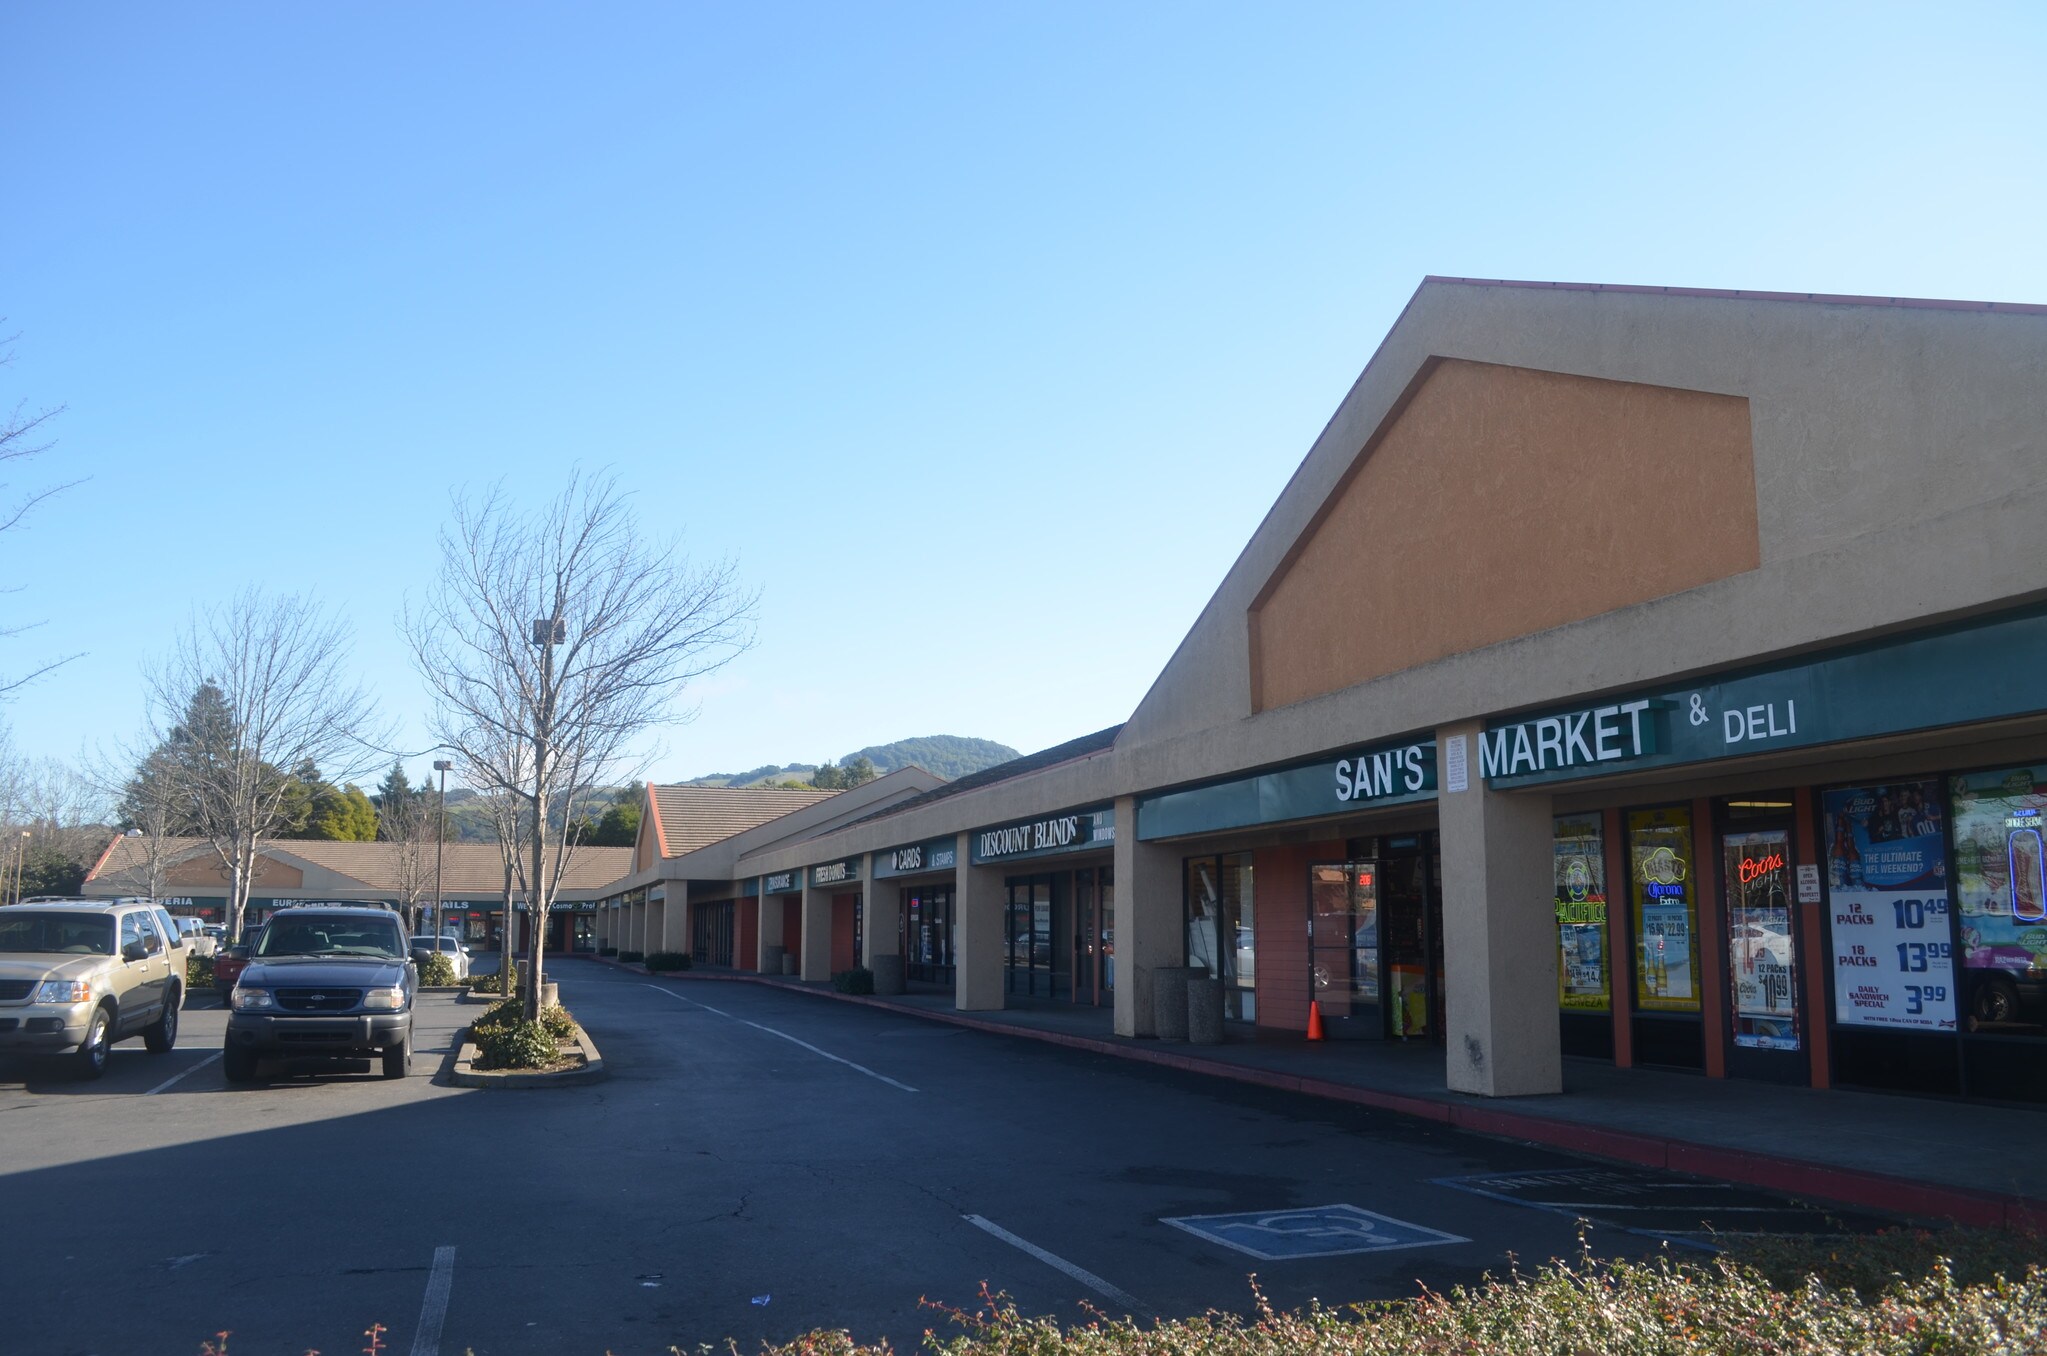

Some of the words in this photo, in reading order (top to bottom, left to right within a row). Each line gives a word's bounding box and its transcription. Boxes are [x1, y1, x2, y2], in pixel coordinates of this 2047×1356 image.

[1477, 699, 1650, 779] MARKET
[1689, 693, 1709, 726] &
[1724, 699, 1797, 744] DELI
[1335, 745, 1424, 801] SAN'S
[1849, 804, 1877, 813] LIGHT
[1093, 812, 1104, 826] AND
[980, 825, 1031, 857] DISCOUNT
[1033, 815, 1078, 849] BLINDS
[898, 846, 921, 870] CARDS
[936, 850, 953, 866] STAMPS
[1864, 853, 1879, 863] THE
[1881, 851, 1922, 863] ULTIMATE
[1738, 853, 1785, 882] Coors
[1865, 865, 1879, 874] NFL
[1880, 863, 1924, 874] WEEKEND?
[1745, 870, 1781, 894] LIGHT
[1648, 881, 1683, 898] Corona
[151, 897, 193, 905] DERIA
[441, 901, 469, 909] AILS
[552, 902, 573, 910] Cosmo
[1849, 903, 1862, 913] 12
[1836, 914, 1874, 925] PACKS
[1851, 945, 1865, 955] 18
[1838, 956, 1878, 967] PACKS
[1758, 963, 1766, 973] 12
[1766, 964, 1787, 974] PACKS
[1857, 985, 1880, 993] DAILY
[1849, 993, 1889, 1001] SANDWICH
[1854, 1000, 1885, 1008] SPECIAL
